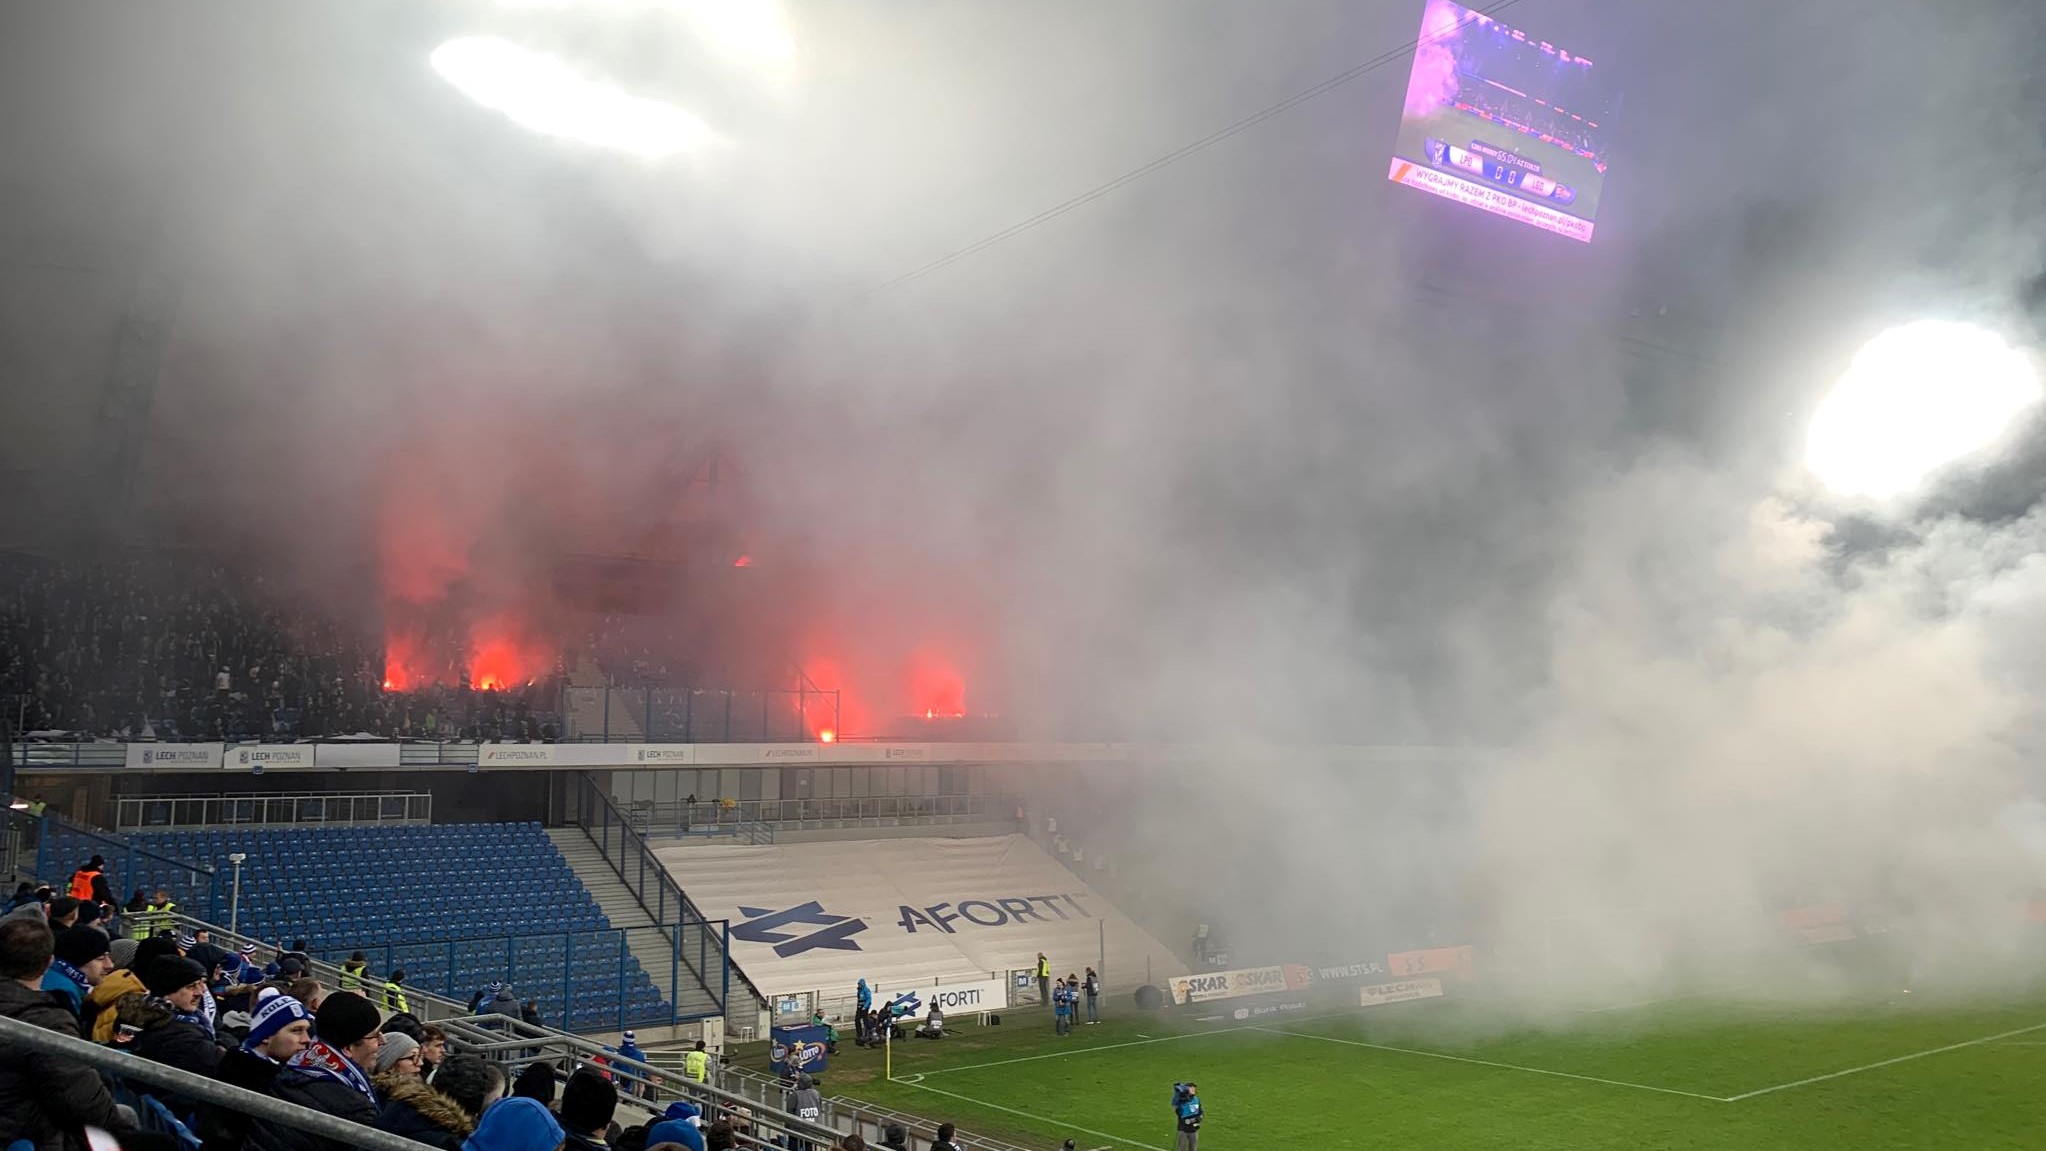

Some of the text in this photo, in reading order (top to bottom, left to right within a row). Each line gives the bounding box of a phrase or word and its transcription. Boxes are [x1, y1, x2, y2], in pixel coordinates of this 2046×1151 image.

[1508, 170, 1516, 184] 0
[1416, 168, 1459, 190] WYGRAJMY
[1460, 182, 1485, 198] RAZEM
[1491, 194, 1507, 206] PKO
[155, 750, 177, 760] LECH
[251, 751, 271, 761] LECH
[897, 893, 1094, 934] AFORTI
[1318, 962, 1385, 980] WWW.STS.PL
[929, 989, 981, 1010] AFORTI
[800, 1046, 820, 1060] LOTTO
[800, 1107, 819, 1118] FOTO
